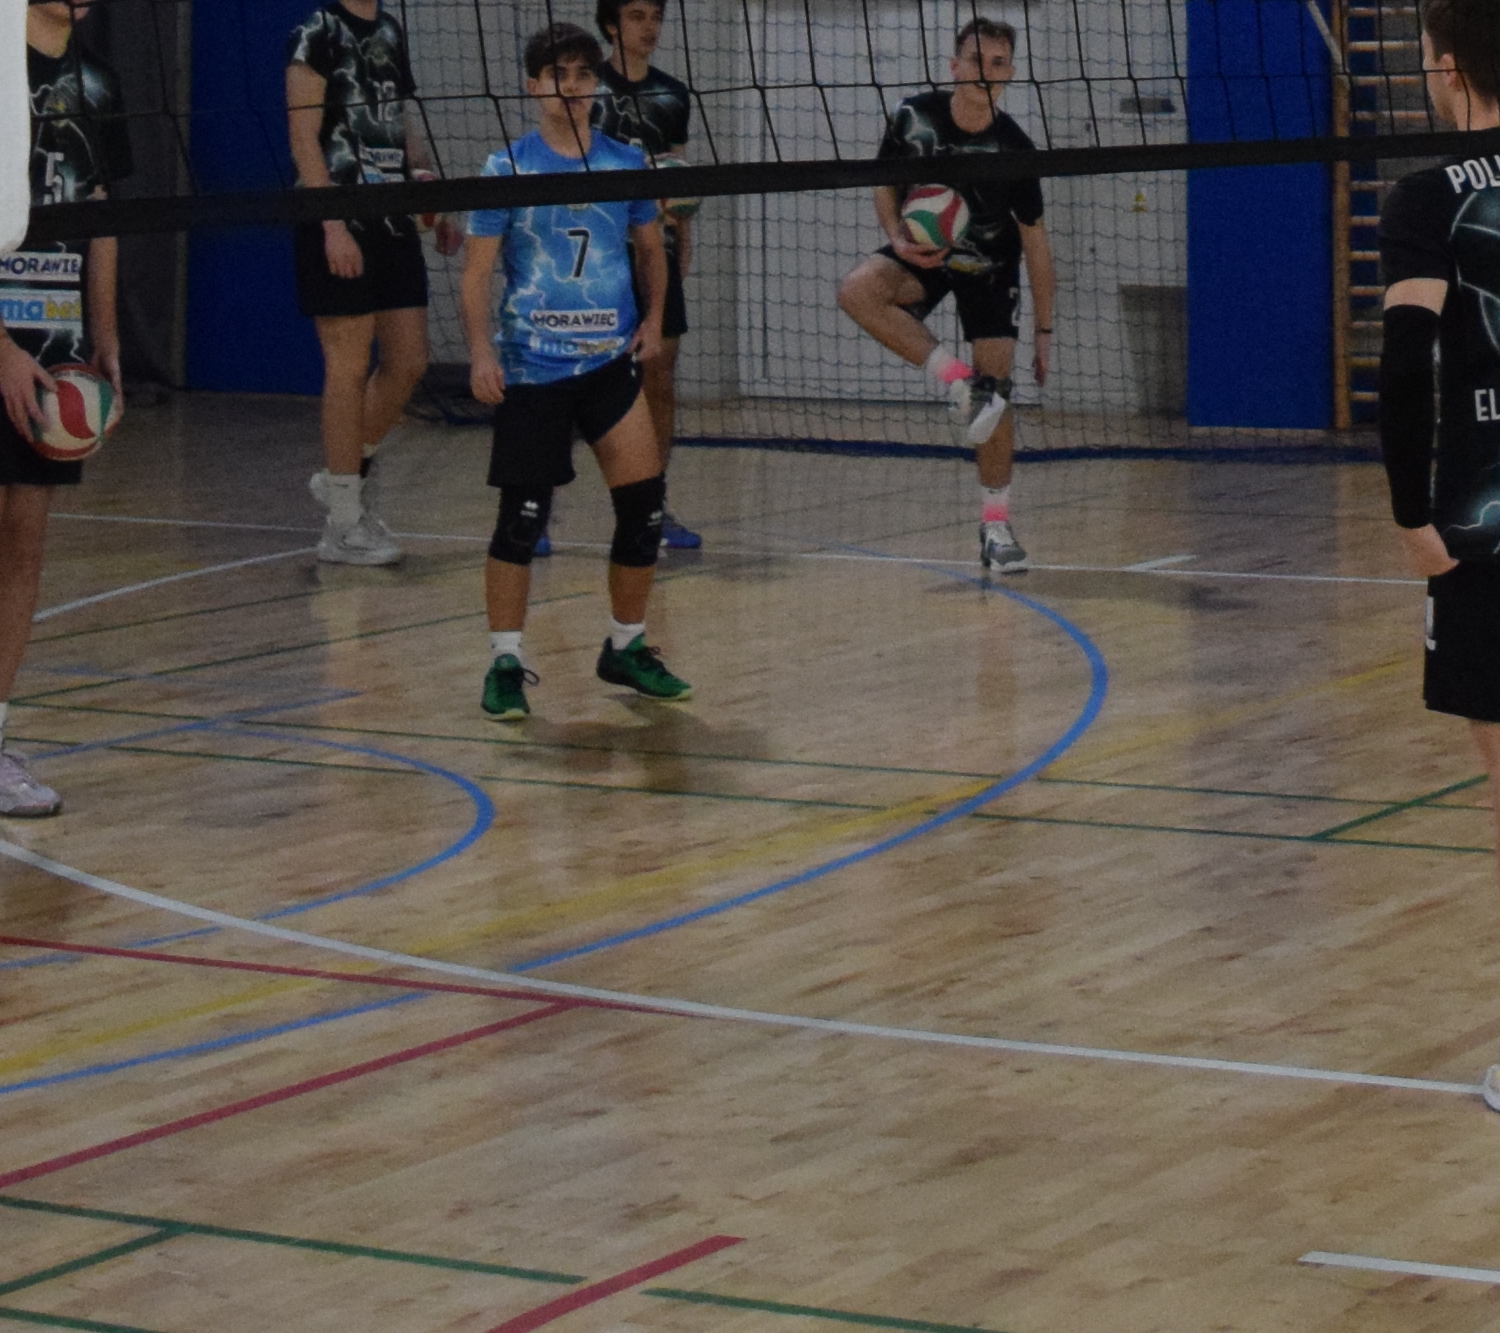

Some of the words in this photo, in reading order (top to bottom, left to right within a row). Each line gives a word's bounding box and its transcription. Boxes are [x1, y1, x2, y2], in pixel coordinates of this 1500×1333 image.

[43, 151, 66, 205] 5
[567, 229, 590, 278] 7
[533, 312, 616, 328] MORAWIEC
